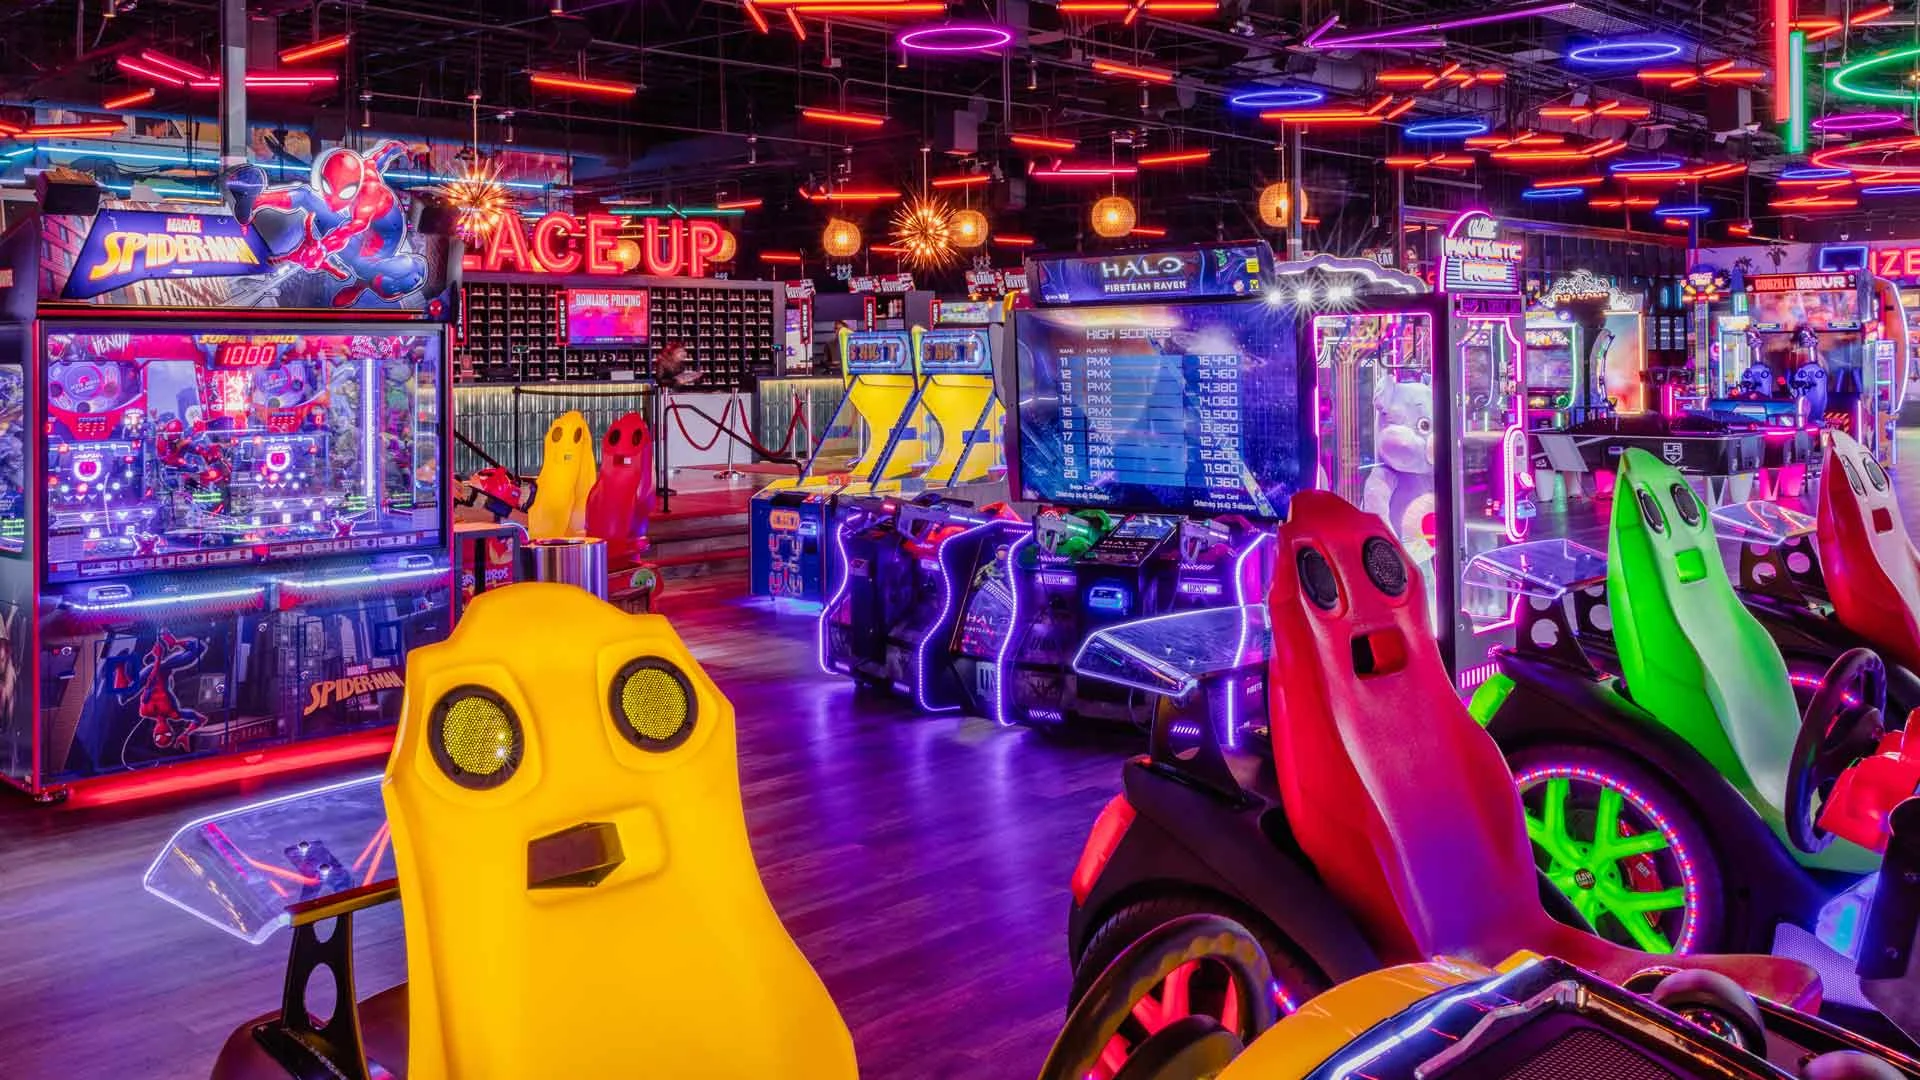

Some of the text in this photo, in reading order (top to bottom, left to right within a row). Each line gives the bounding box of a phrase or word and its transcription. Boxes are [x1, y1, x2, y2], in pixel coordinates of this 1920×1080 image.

[166, 217, 202, 233] MARVEL
[643, 216, 725, 278] UP
[89, 231, 260, 280] SPIDER-MAN
[1101, 256, 1184, 278] HALO
[1104, 279, 1187, 293] FIRETEAM RAVEN
[1755, 278, 1795, 291] GODZILLA
[575, 293, 641, 307] BOWLING PRICING
[1086, 327, 1172, 340] HIGH SCORES
[223, 346, 275, 365] 1000
[1060, 356, 1237, 367] 11 PMX 16,440
[1060, 369, 1238, 380] 12 PMX 15,460
[1060, 382, 1238, 393] 13 PMX 14,380
[1061, 395, 1238, 407] 14 PMX 14,060
[1062, 407, 1239, 420] 15 PMX 13,500
[1062, 419, 1073, 429] 16
[1199, 423, 1239, 434] 13,260
[1062, 431, 1240, 448] 17 PMX 12,770
[1063, 444, 1240, 461] 18 PMX 12,200
[1063, 456, 1240, 475] 19 PMX 11,900
[1063, 469, 1241, 488] 20 PMX 11,360
[303, 670, 405, 715] SPIDER-MAN
